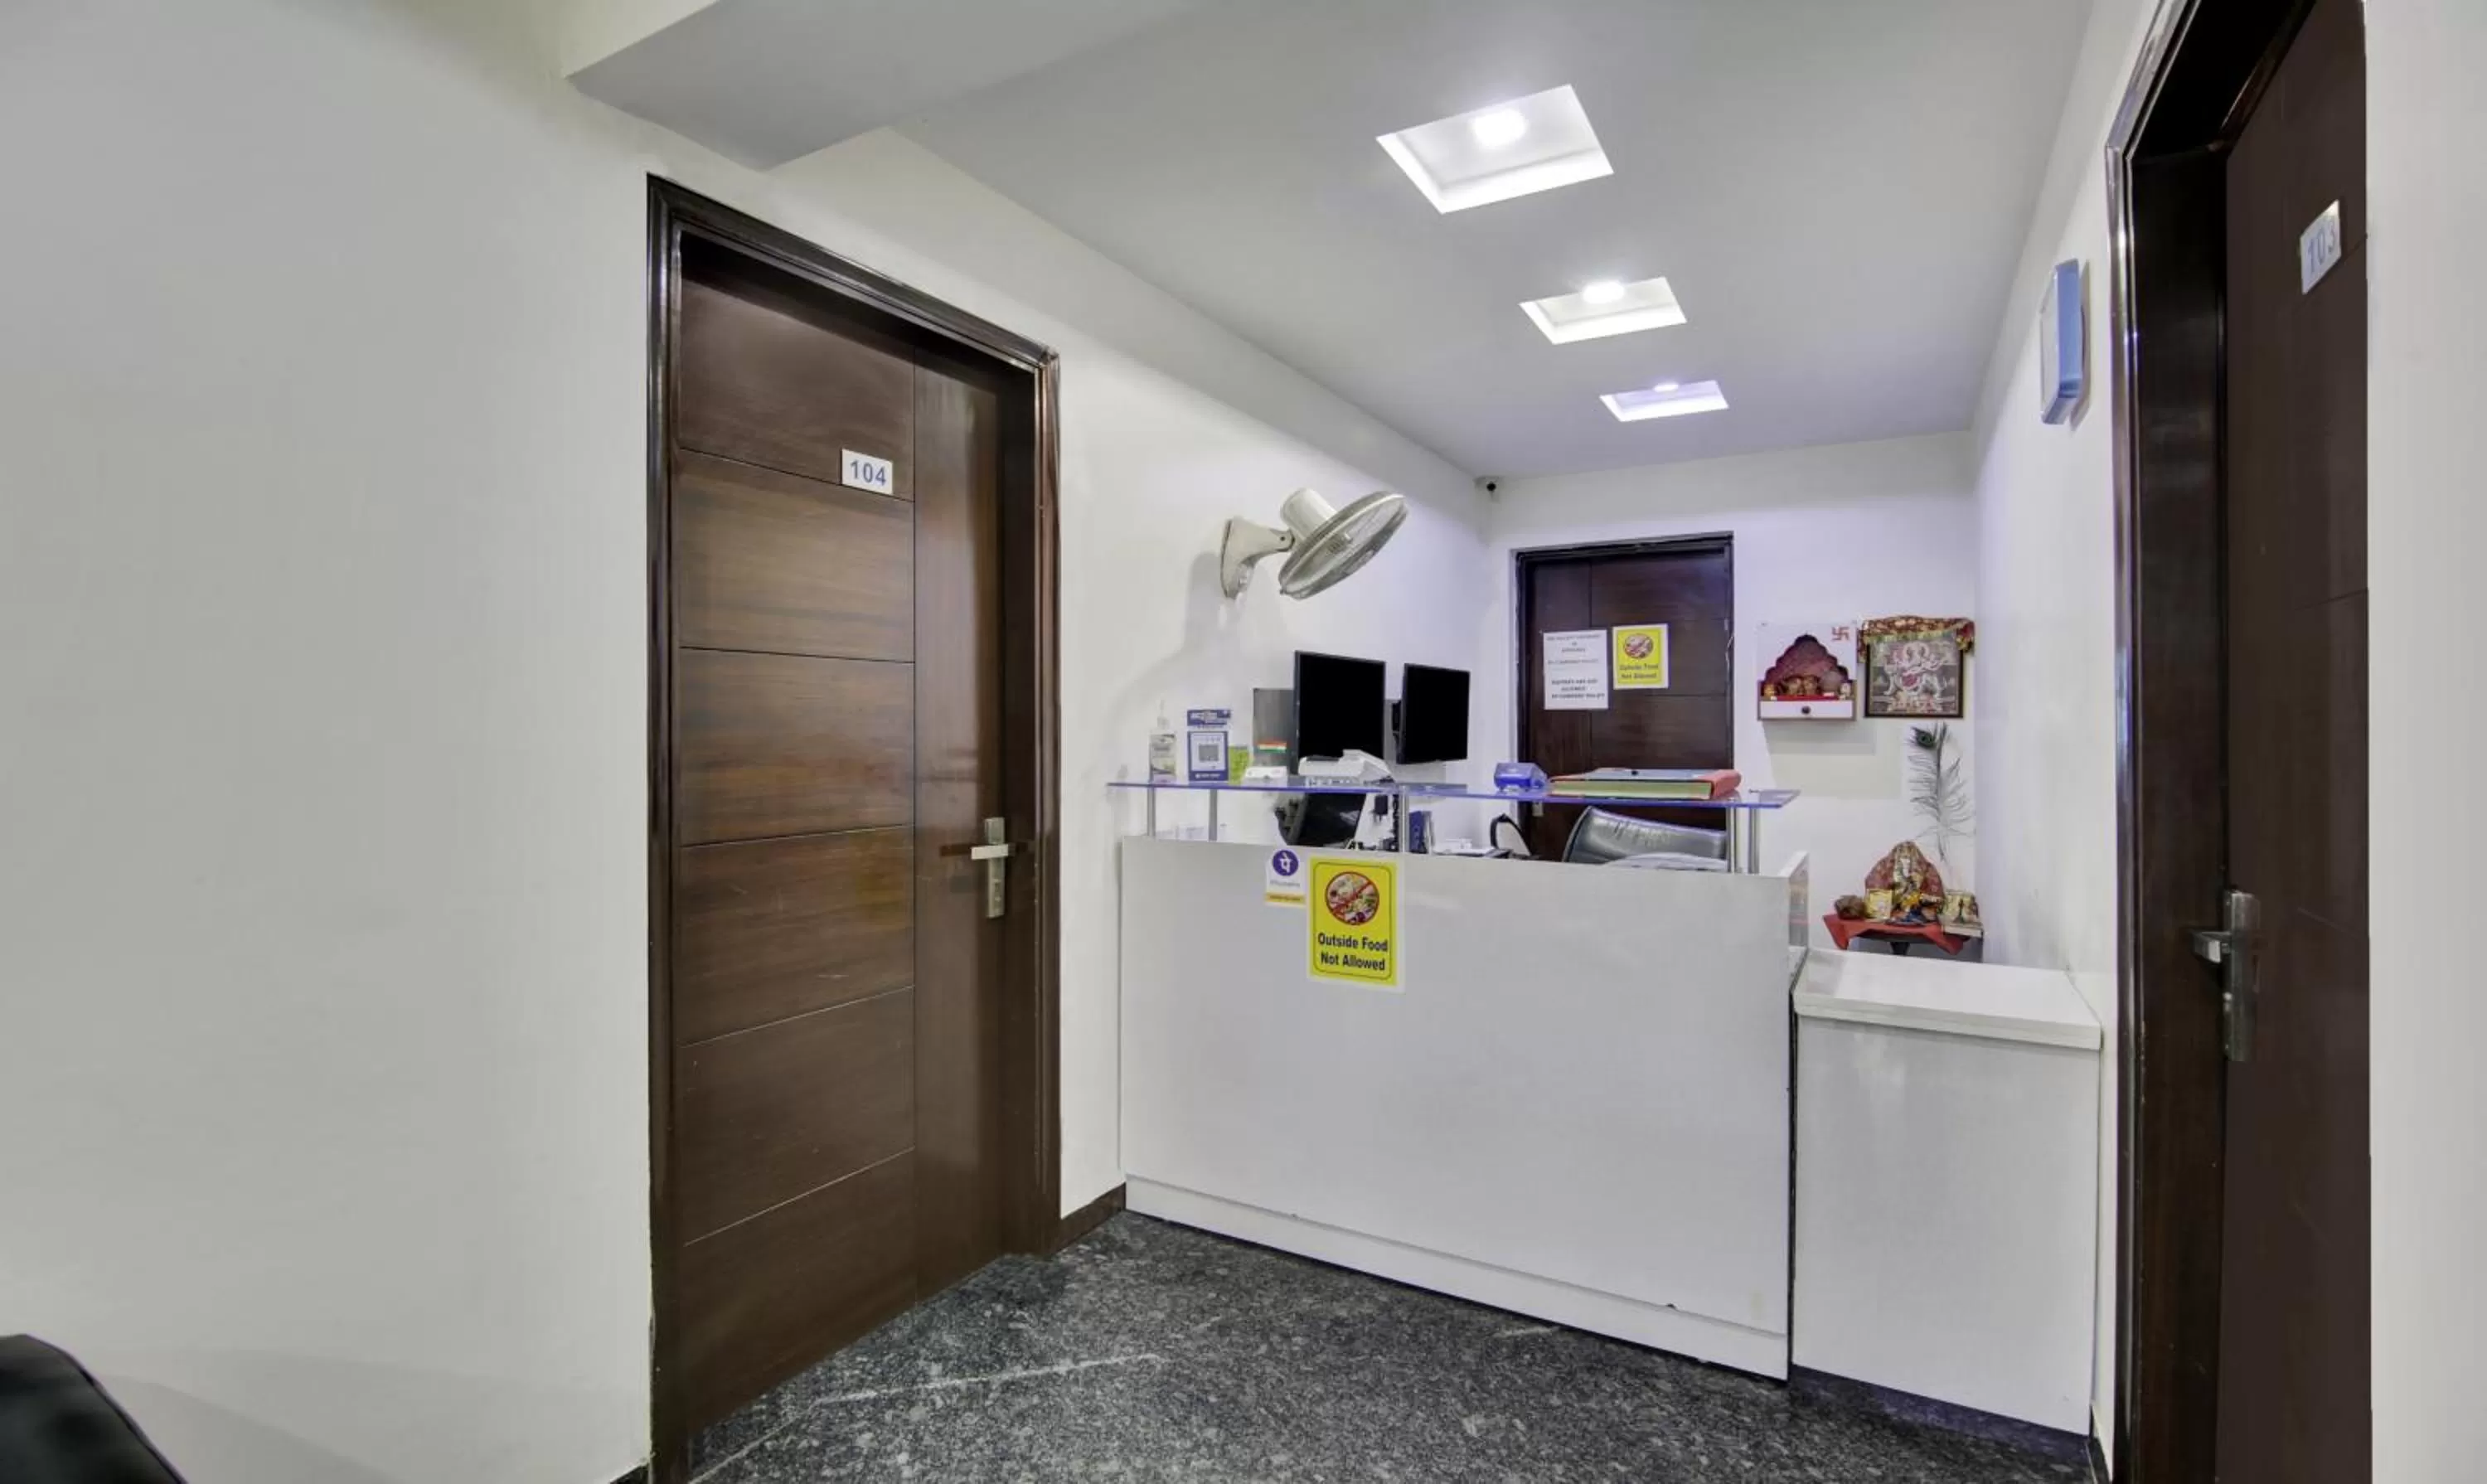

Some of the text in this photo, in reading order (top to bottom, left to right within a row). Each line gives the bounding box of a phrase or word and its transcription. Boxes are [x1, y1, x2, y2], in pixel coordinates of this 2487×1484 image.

[2307, 220, 2335, 274] 103
[850, 458, 887, 487] 104
[1317, 932, 1389, 953] Outside Food
[1320, 952, 1386, 972] Not Allowed
